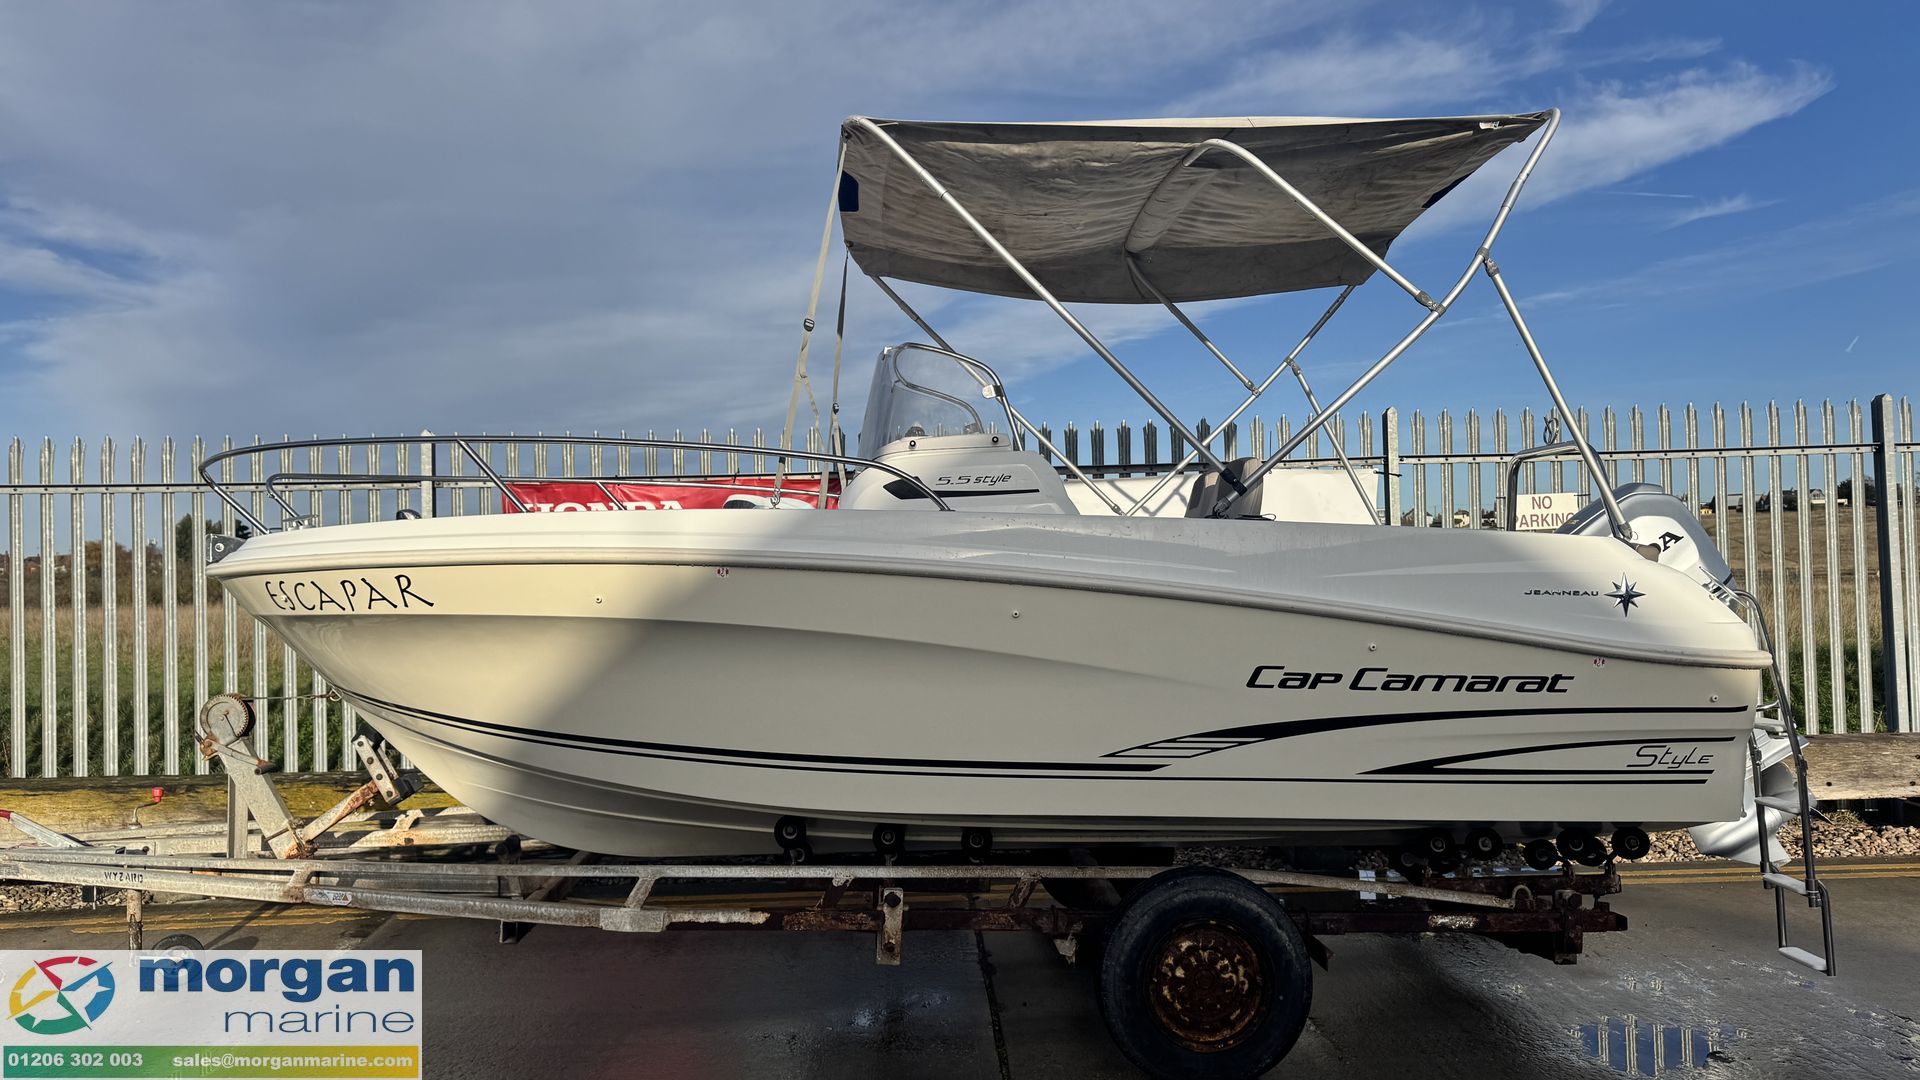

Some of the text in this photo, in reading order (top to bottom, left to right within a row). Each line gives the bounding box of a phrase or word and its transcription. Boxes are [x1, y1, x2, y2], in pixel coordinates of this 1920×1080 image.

[936, 473, 1012, 487] 5.5 style
[1531, 495, 1553, 510] NO
[265, 573, 435, 612] ESCAPAR
[1524, 589, 1600, 598] JEANNEAU
[1246, 664, 1574, 694] Cap Camarat
[104, 871, 144, 884] WYZARD
